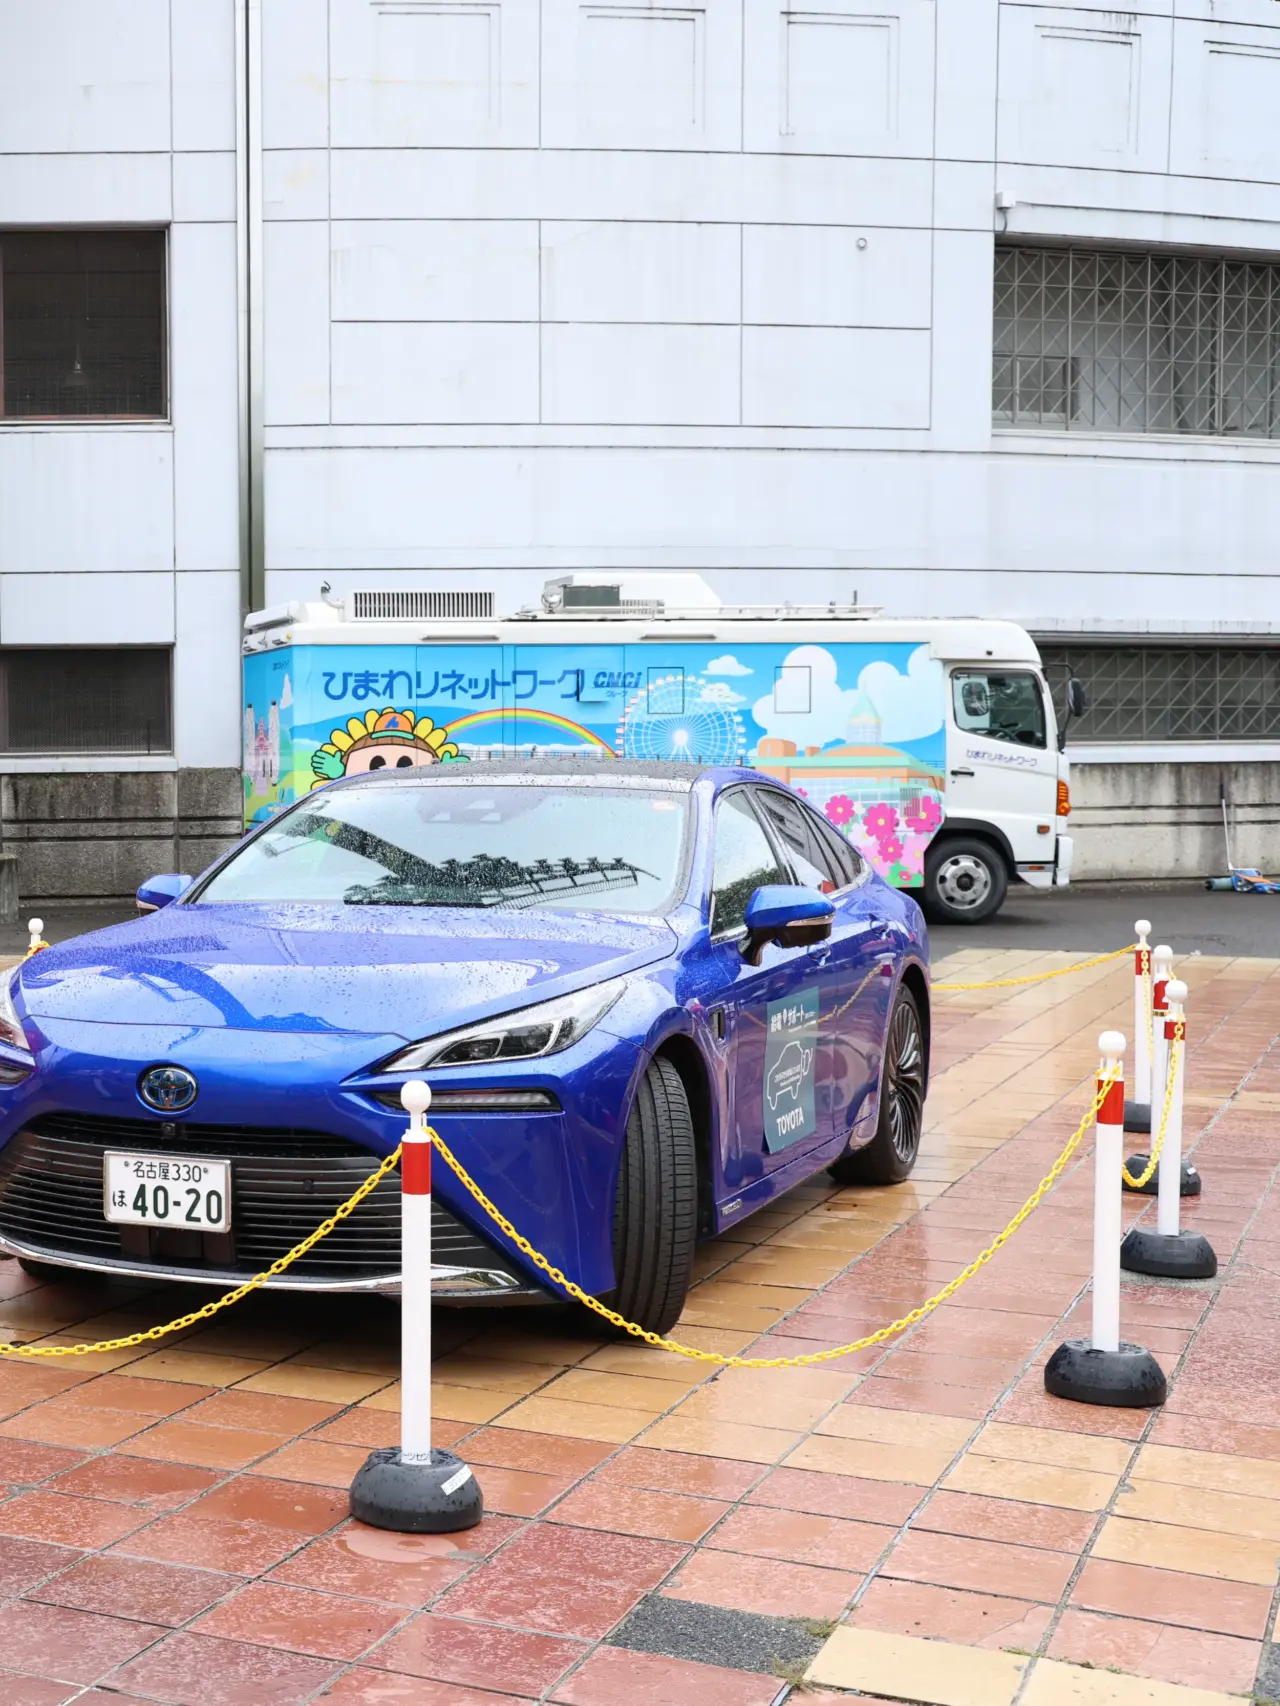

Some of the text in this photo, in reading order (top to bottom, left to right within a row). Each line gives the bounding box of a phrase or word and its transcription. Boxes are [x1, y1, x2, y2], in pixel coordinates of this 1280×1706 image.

[322, 669, 585, 700] ひまわりネットワーク
[776, 1106, 804, 1136] TOYOTA
[112, 1183, 223, 1224] ほ 40-20
